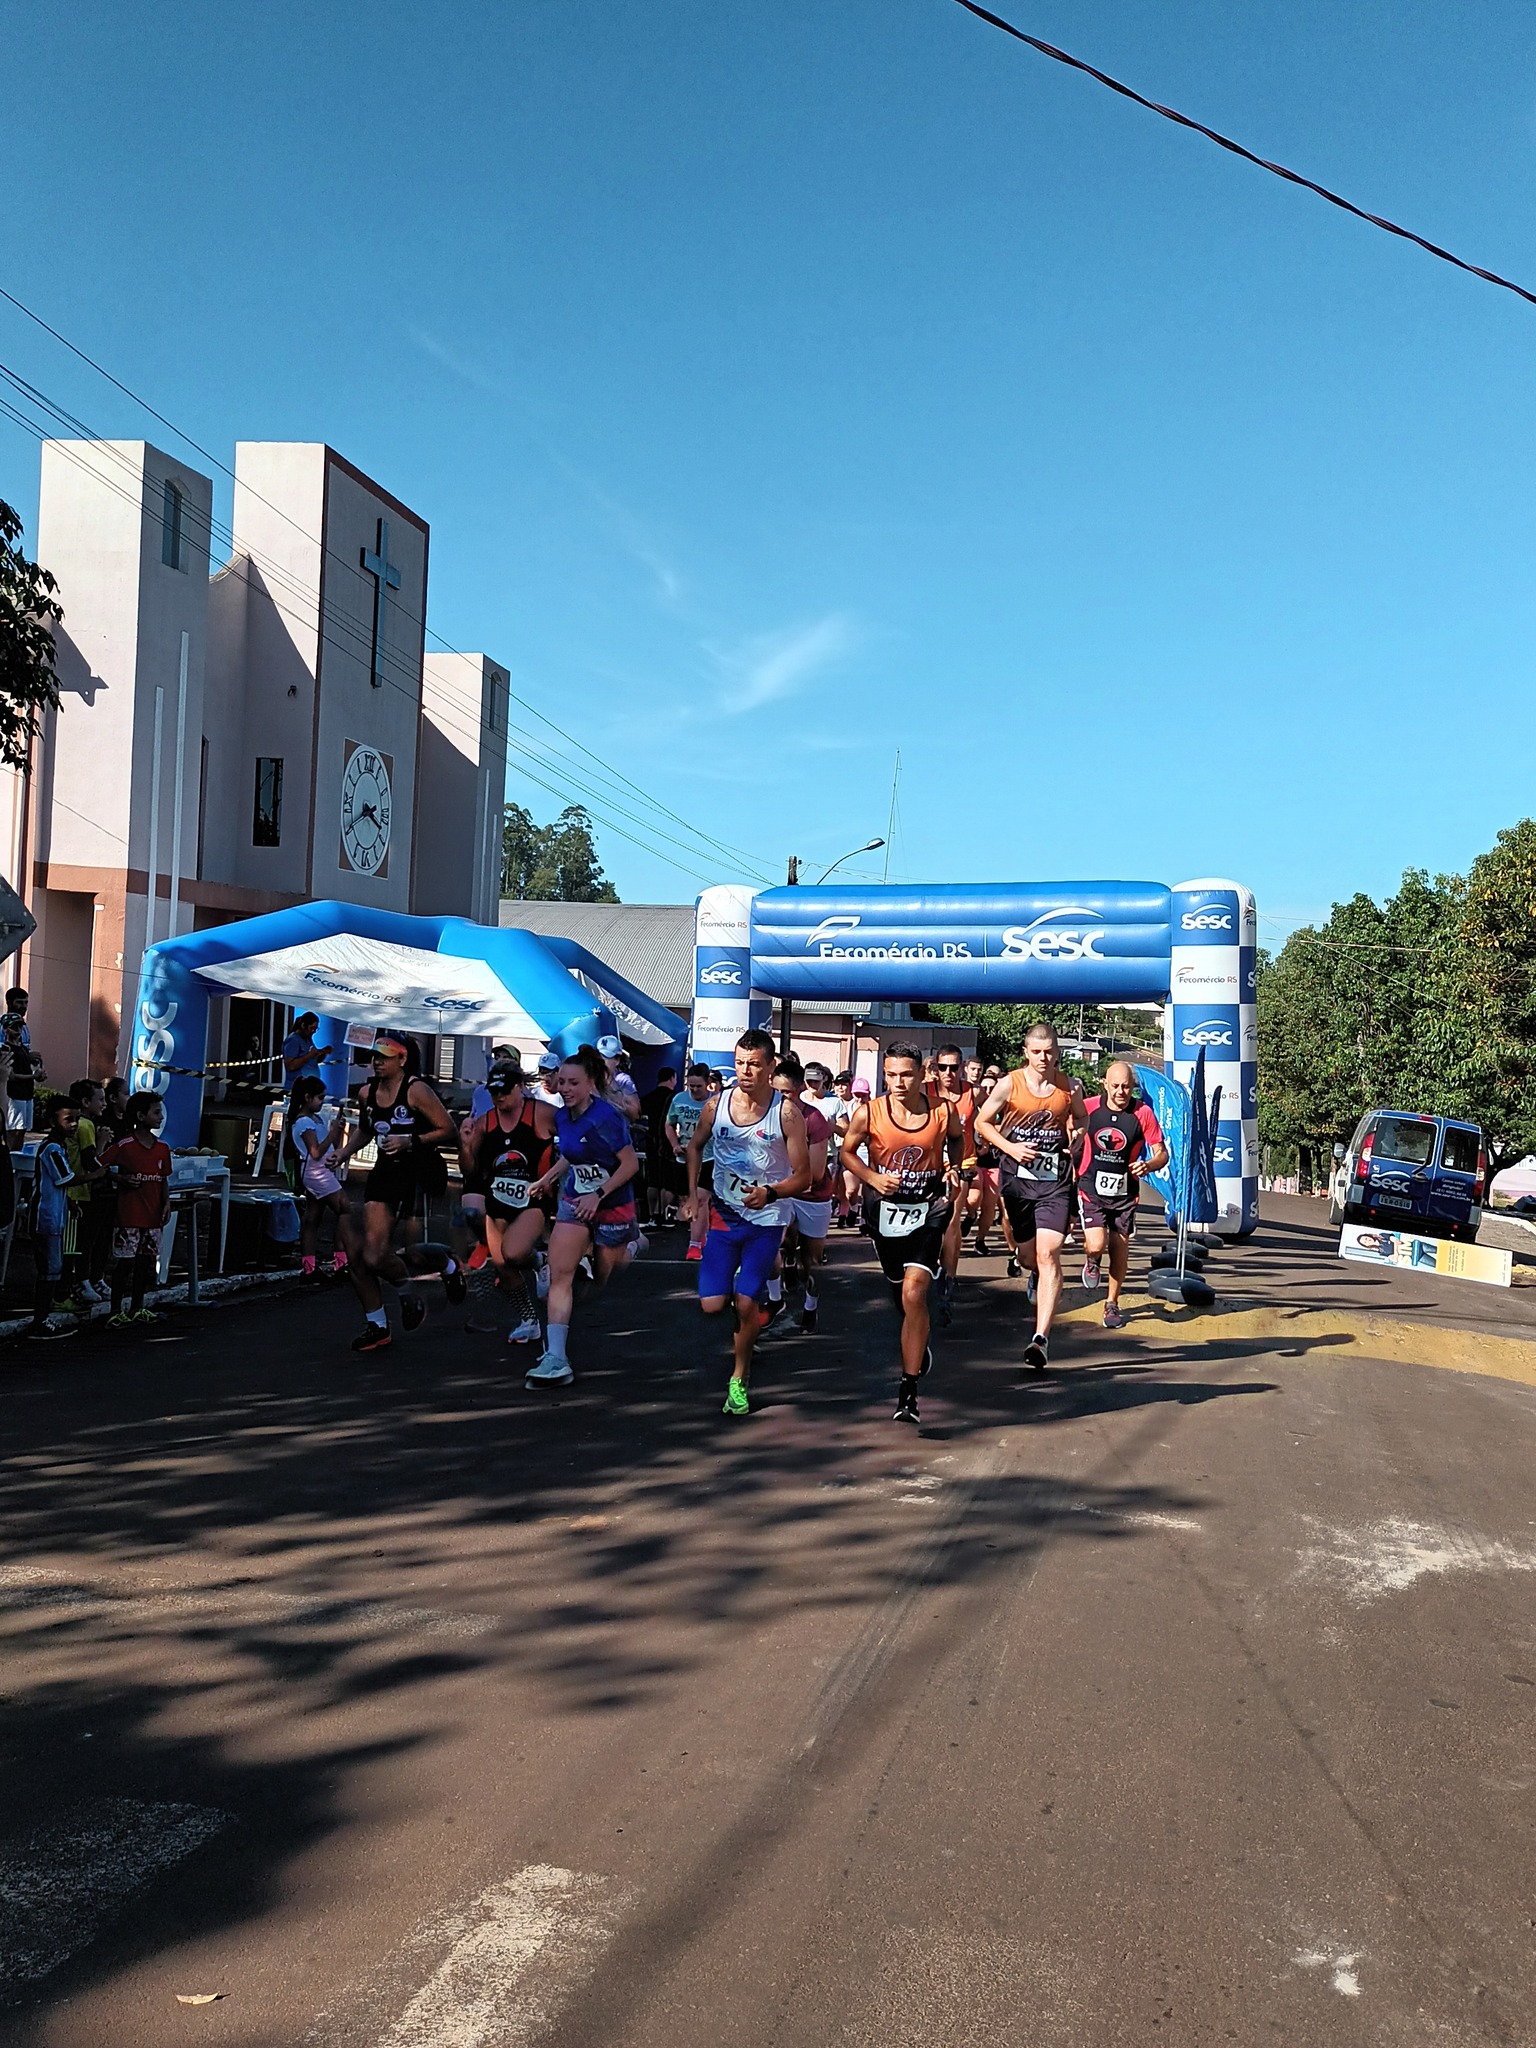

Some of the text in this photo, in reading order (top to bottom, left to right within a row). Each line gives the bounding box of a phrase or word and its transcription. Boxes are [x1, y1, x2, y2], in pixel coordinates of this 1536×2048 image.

[700, 920, 748, 929] Fecomércio RS
[818, 941, 972, 959] Fecomércio RS
[1179, 975, 1225, 984] Fecomércio
[1227, 976, 1238, 984] RS
[304, 972, 402, 1005] Fecomércio RS
[697, 1024, 734, 1033] Fecomércio
[685, 1121, 697, 1132] 71
[1025, 1156, 1053, 1172] 878
[576, 1166, 604, 1184] 944
[496, 1180, 526, 1200] 858
[1100, 1176, 1124, 1190] 875
